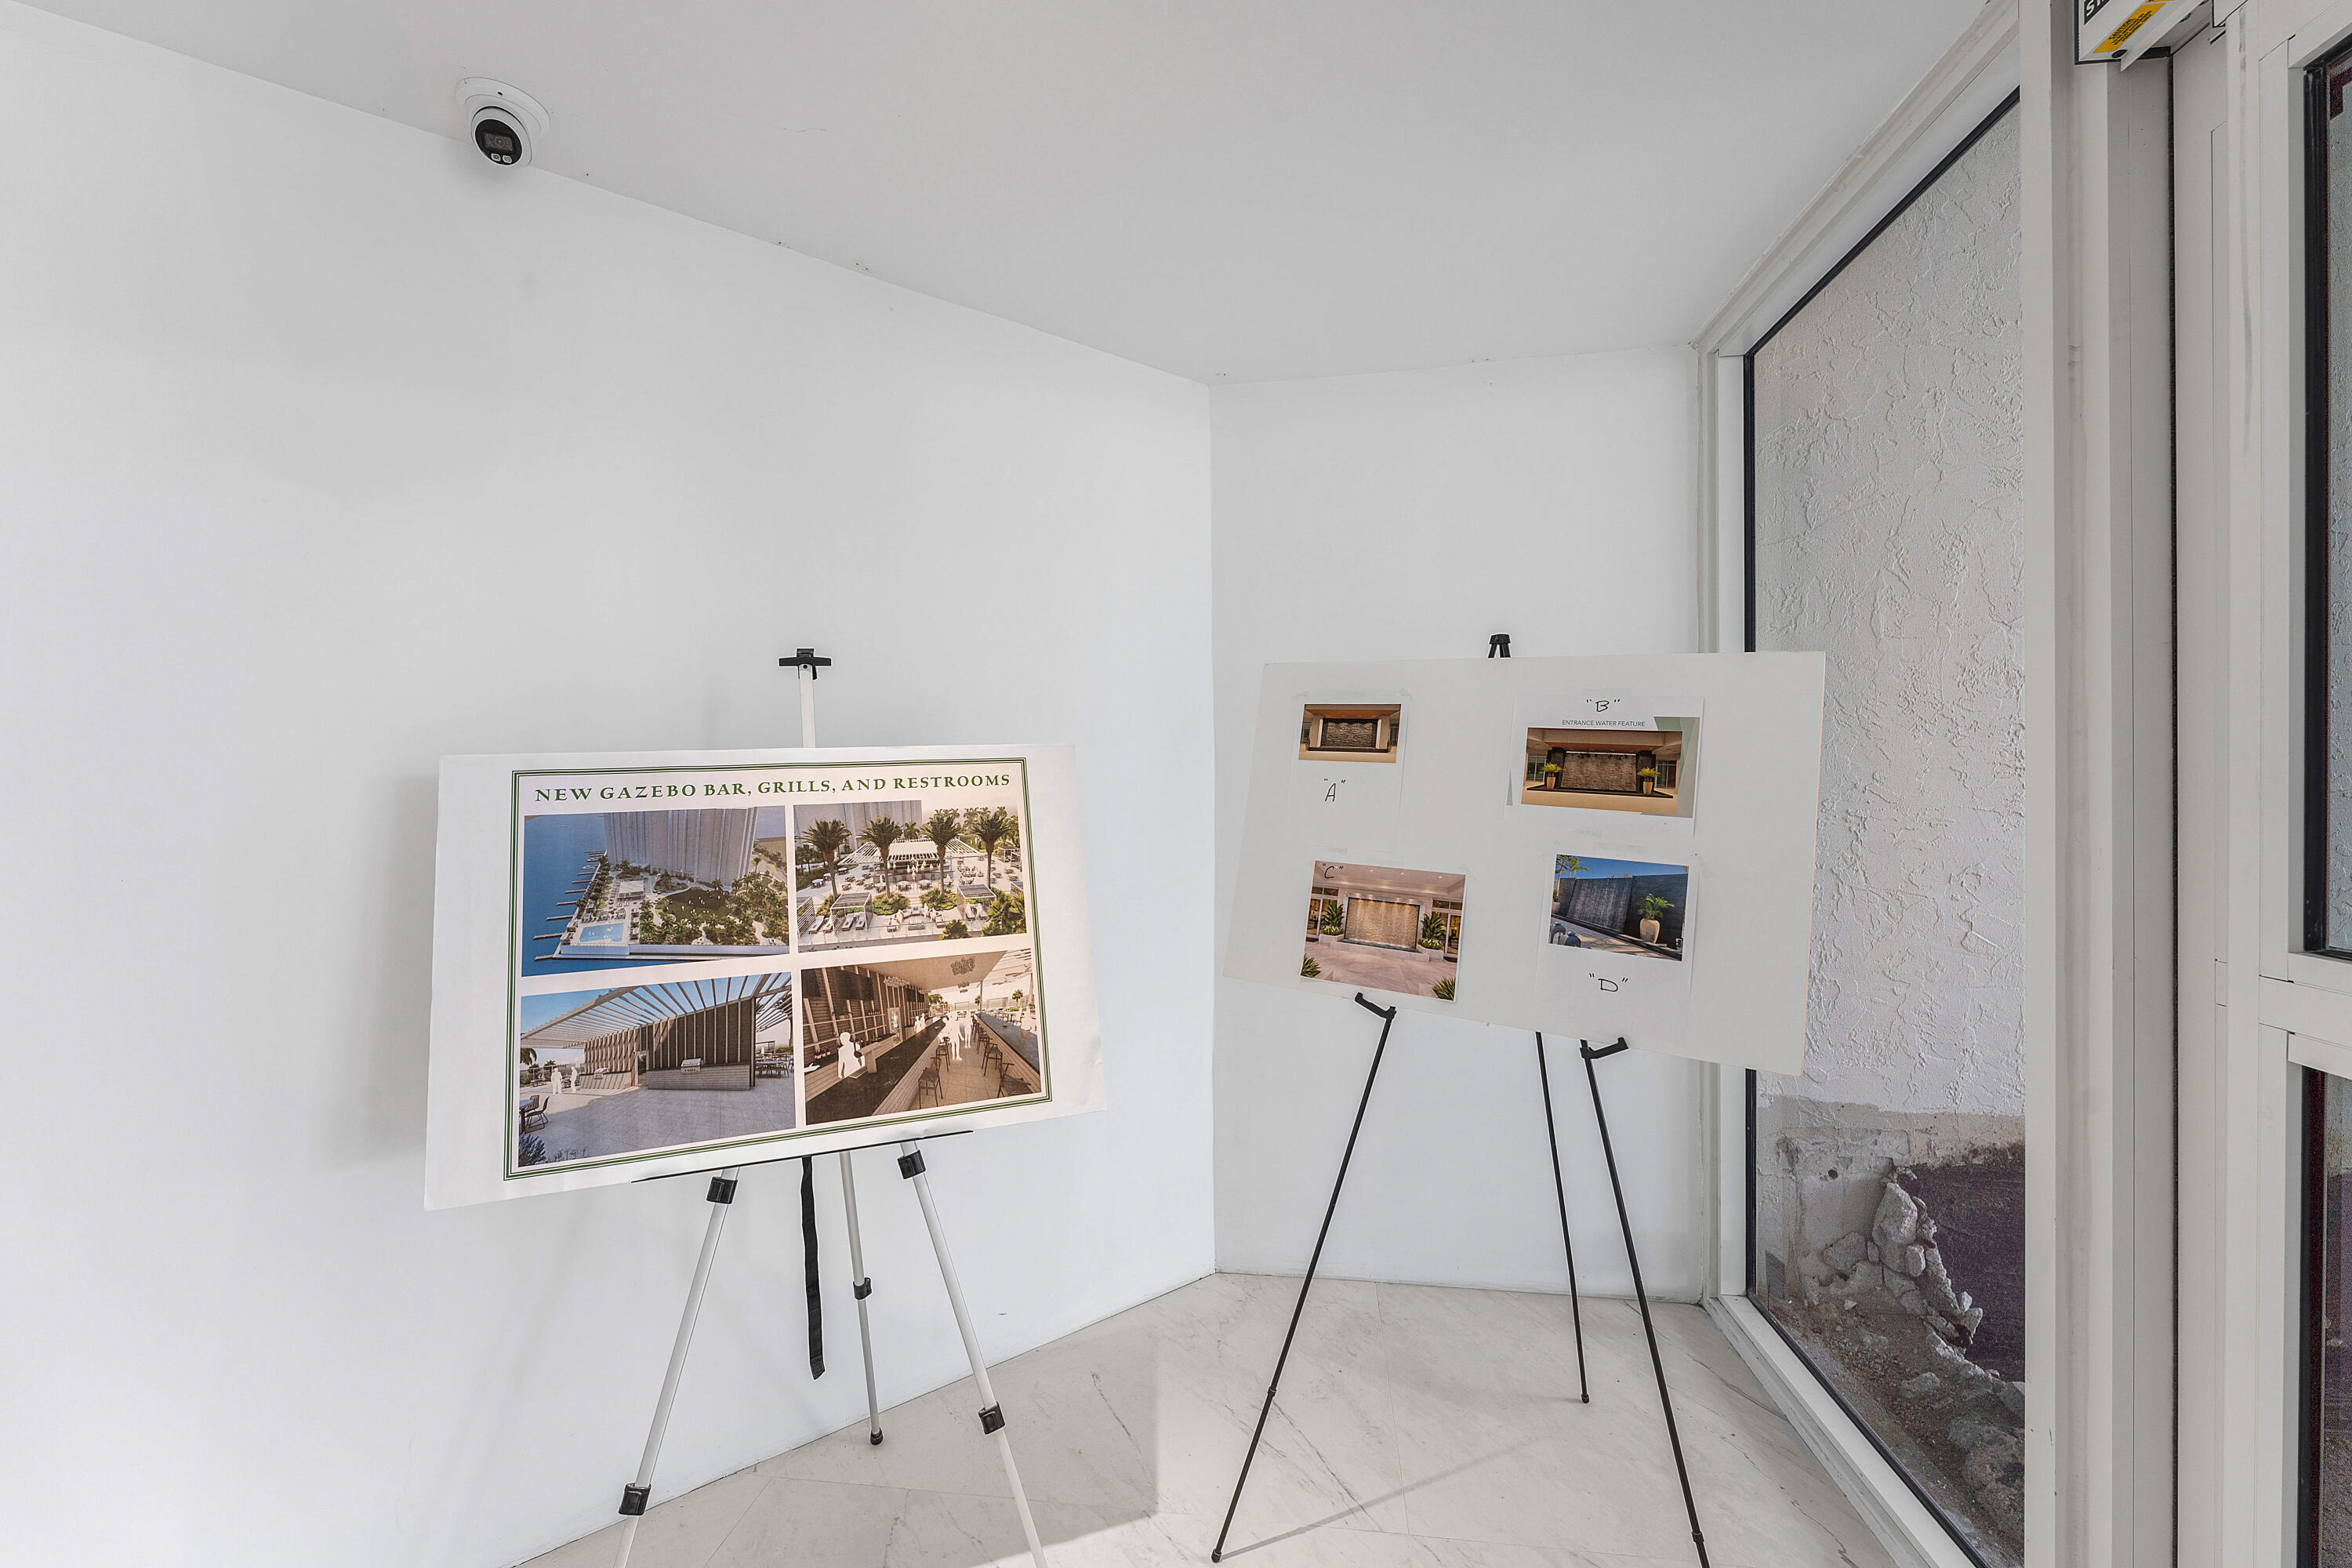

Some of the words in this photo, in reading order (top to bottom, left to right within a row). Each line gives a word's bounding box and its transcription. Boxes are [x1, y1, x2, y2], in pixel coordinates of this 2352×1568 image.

[534, 787, 593, 802] NEW
[600, 784, 696, 800] GAZEBO
[702, 782, 752, 797] BAR,
[757, 779, 836, 794] GRILLS,
[840, 779, 886, 791] AND
[892, 774, 1010, 789] RESTROOMS
